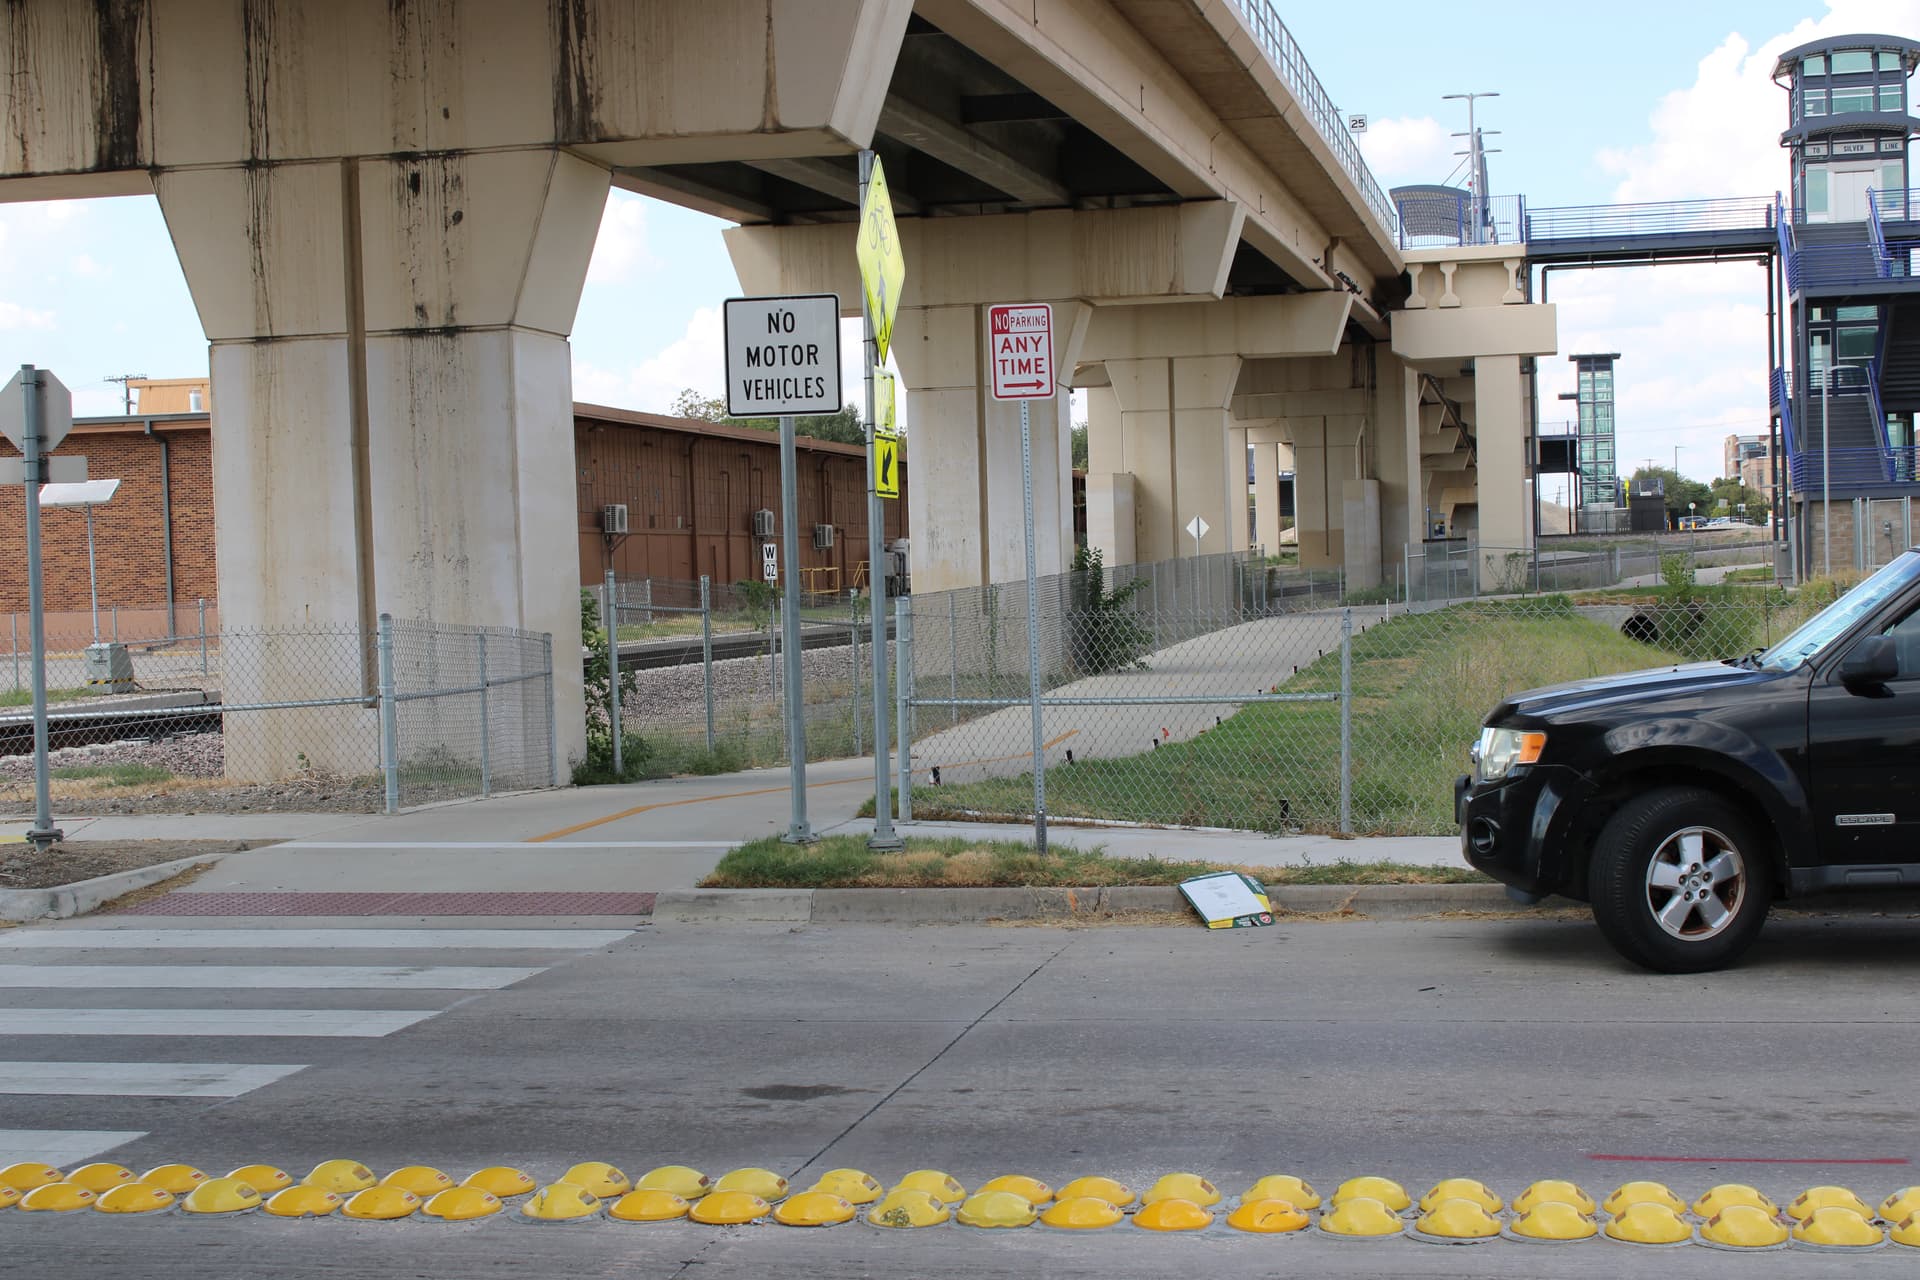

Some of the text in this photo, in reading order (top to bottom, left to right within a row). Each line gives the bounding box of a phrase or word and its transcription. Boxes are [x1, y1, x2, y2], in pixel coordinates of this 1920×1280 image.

[1351, 118, 1366, 129] 25
[1843, 144, 1865, 153] SILVER
[1884, 142, 1899, 150] LINE
[767, 311, 796, 334] NO
[994, 313, 1047, 331] NO PARKING
[1000, 335, 1043, 354] ANY
[746, 343, 819, 368] MOTOR
[998, 357, 1046, 376] TIME
[743, 376, 825, 401] VEHICLES
[764, 546, 775, 560] W
[765, 563, 776, 577] QZ
[1839, 815, 1892, 824] ESCAPE
